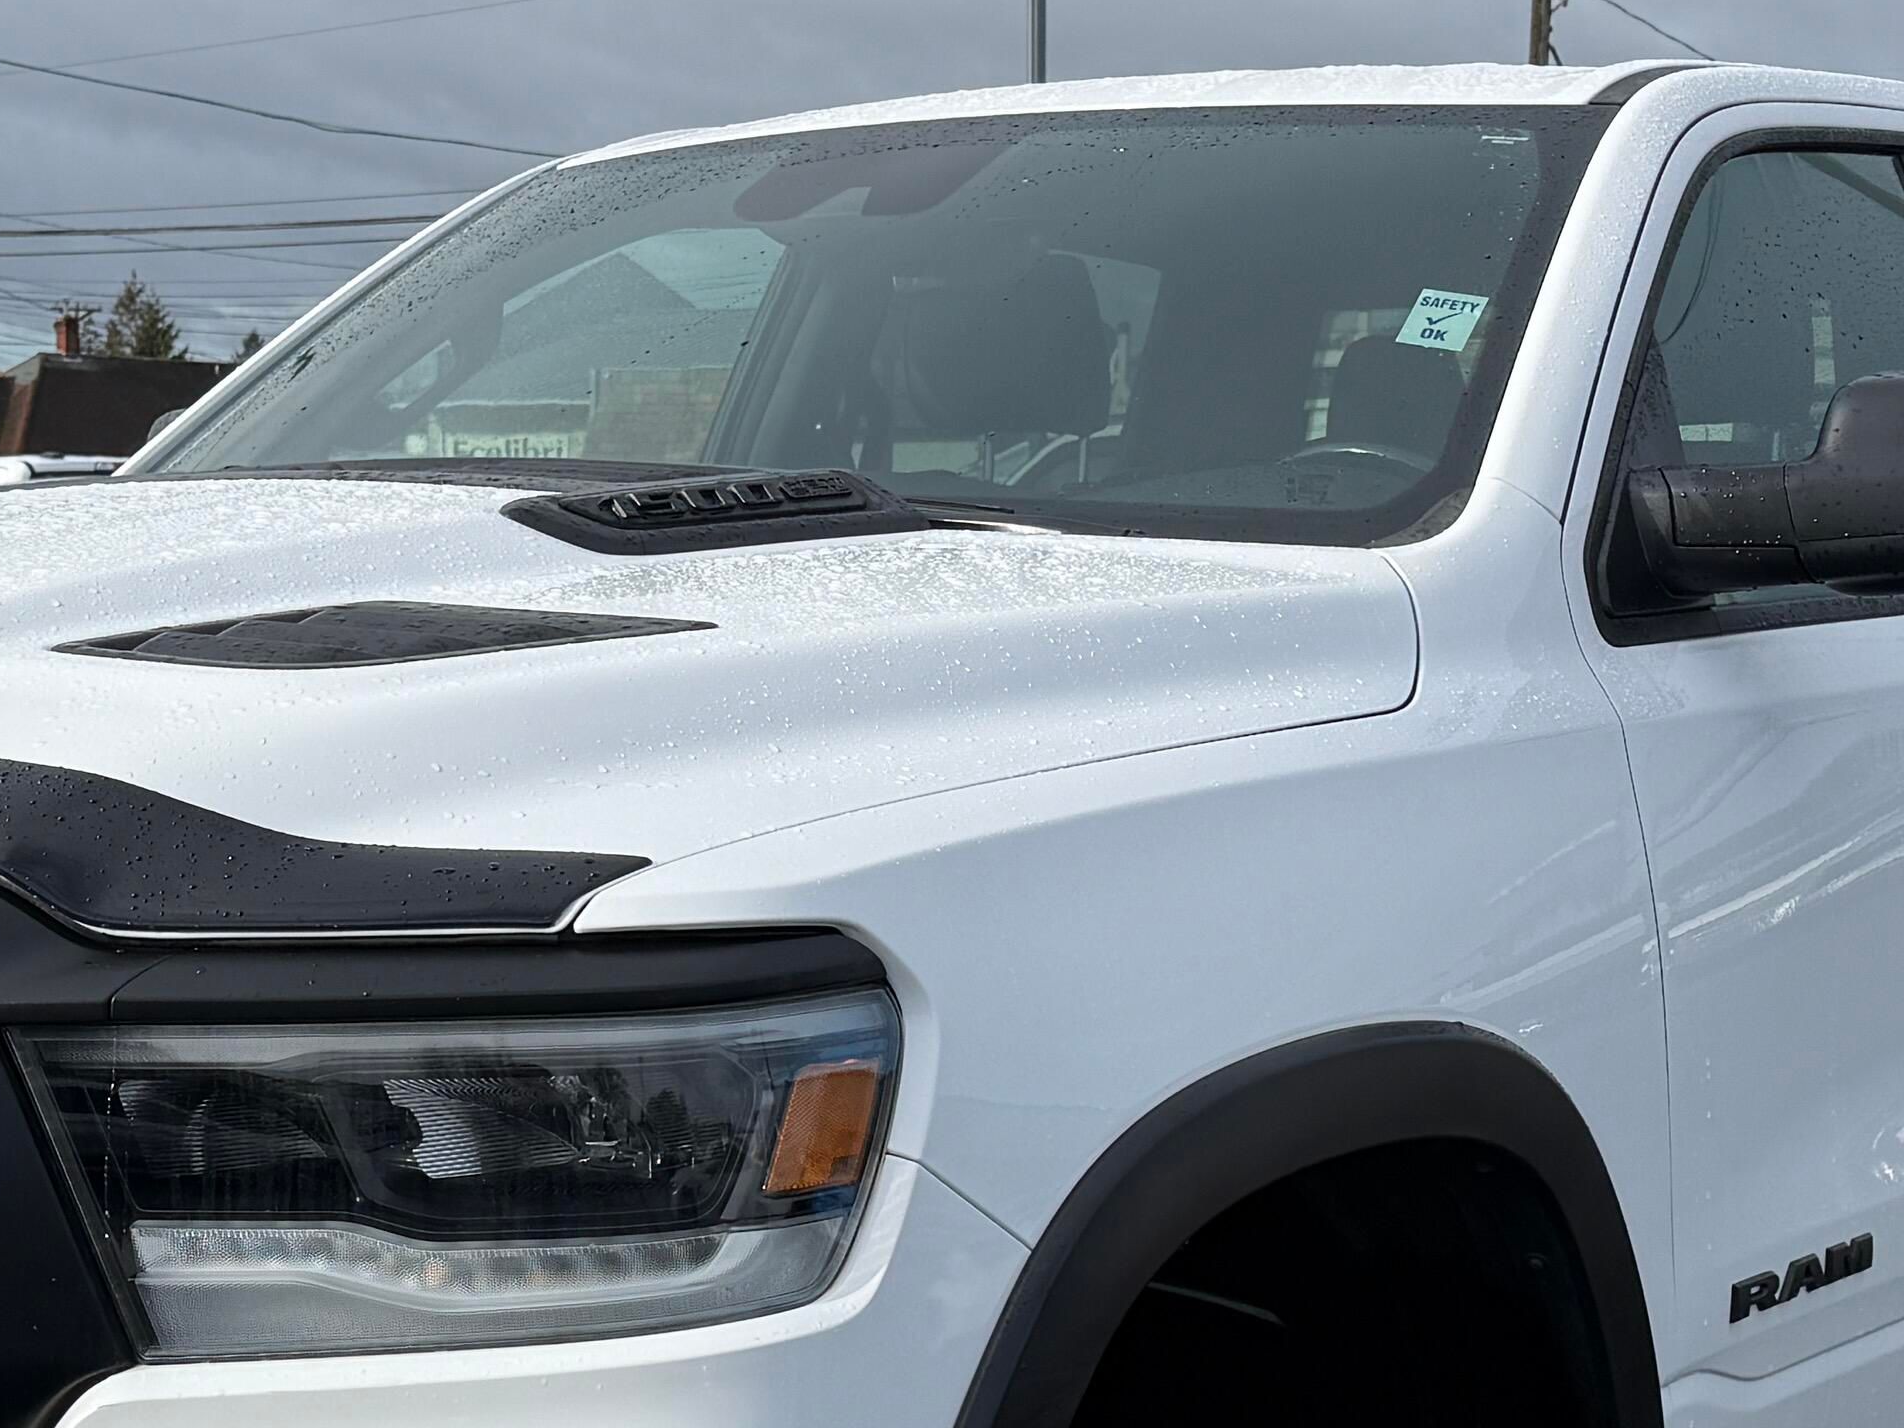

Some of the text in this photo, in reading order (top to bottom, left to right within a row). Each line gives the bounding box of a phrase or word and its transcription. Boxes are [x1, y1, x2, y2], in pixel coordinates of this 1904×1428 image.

[1420, 296, 1480, 314] SAFETY
[1420, 328, 1448, 342] OK
[1729, 1231, 1873, 1324] RAM
